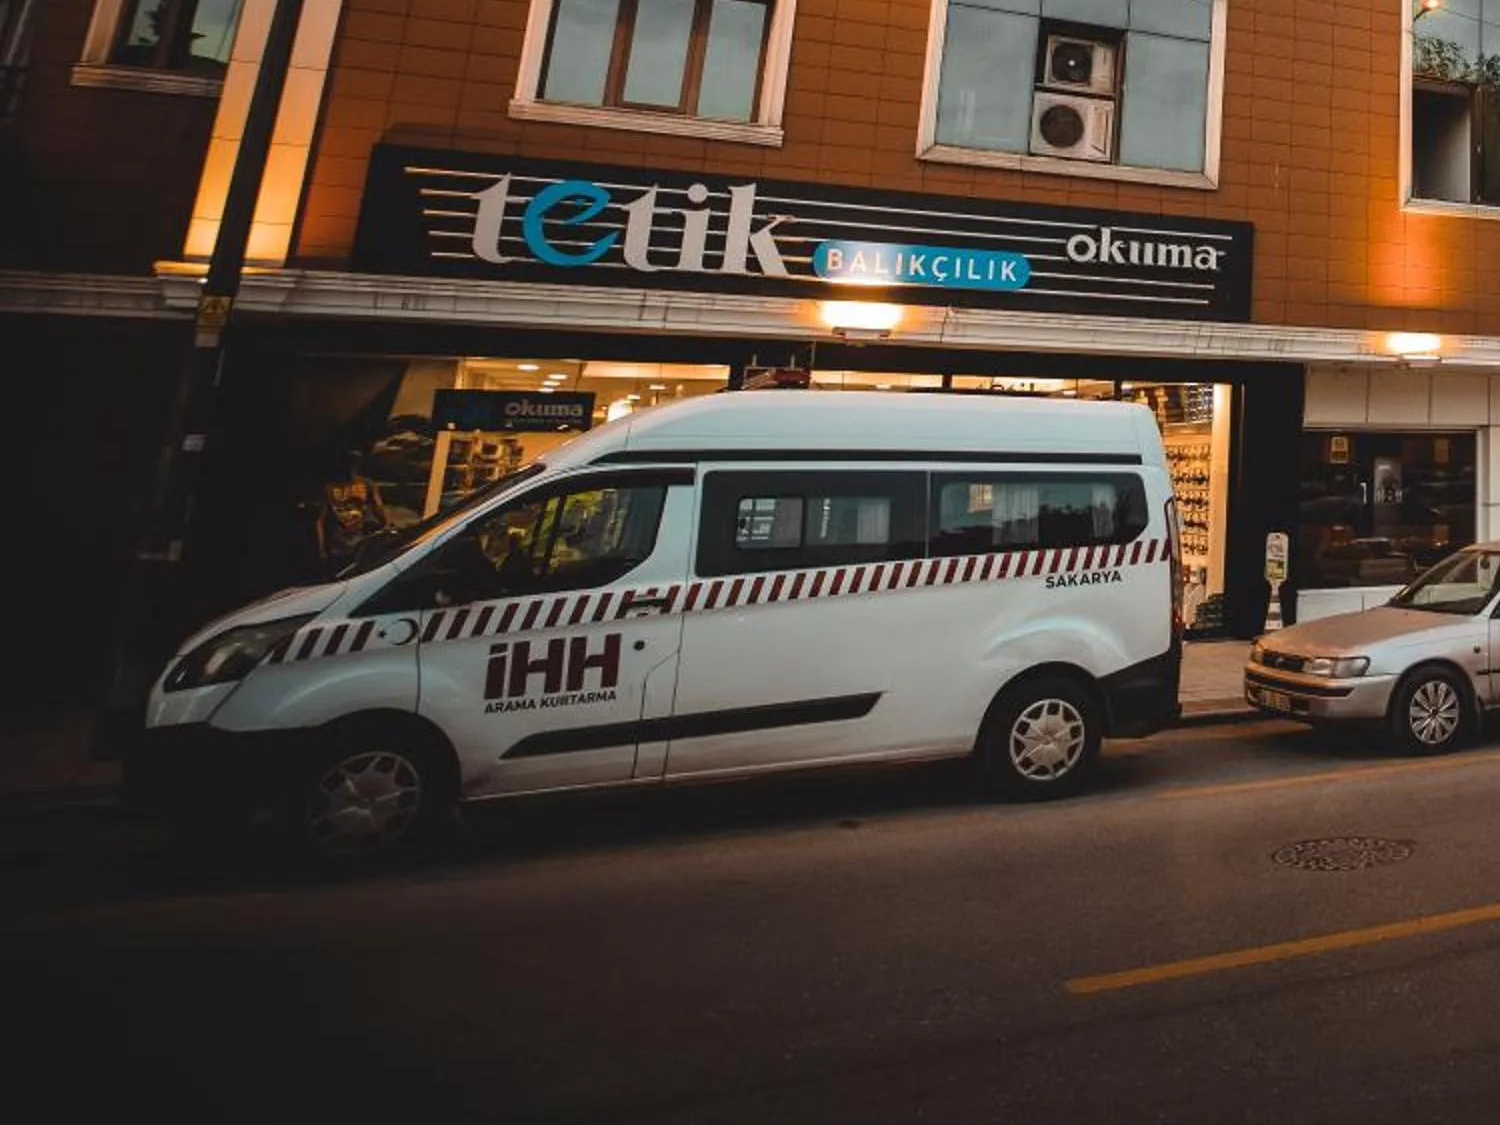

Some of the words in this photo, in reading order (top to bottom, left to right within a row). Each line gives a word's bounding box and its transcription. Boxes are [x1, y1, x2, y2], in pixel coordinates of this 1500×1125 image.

[470, 171, 794, 276] tetik
[1066, 226, 1222, 271] okuma
[826, 247, 1018, 282] BALIKÇILIK
[505, 398, 584, 417] okuma
[1045, 570, 1123, 589] SAKARYA
[484, 698, 536, 715] ARAMA
